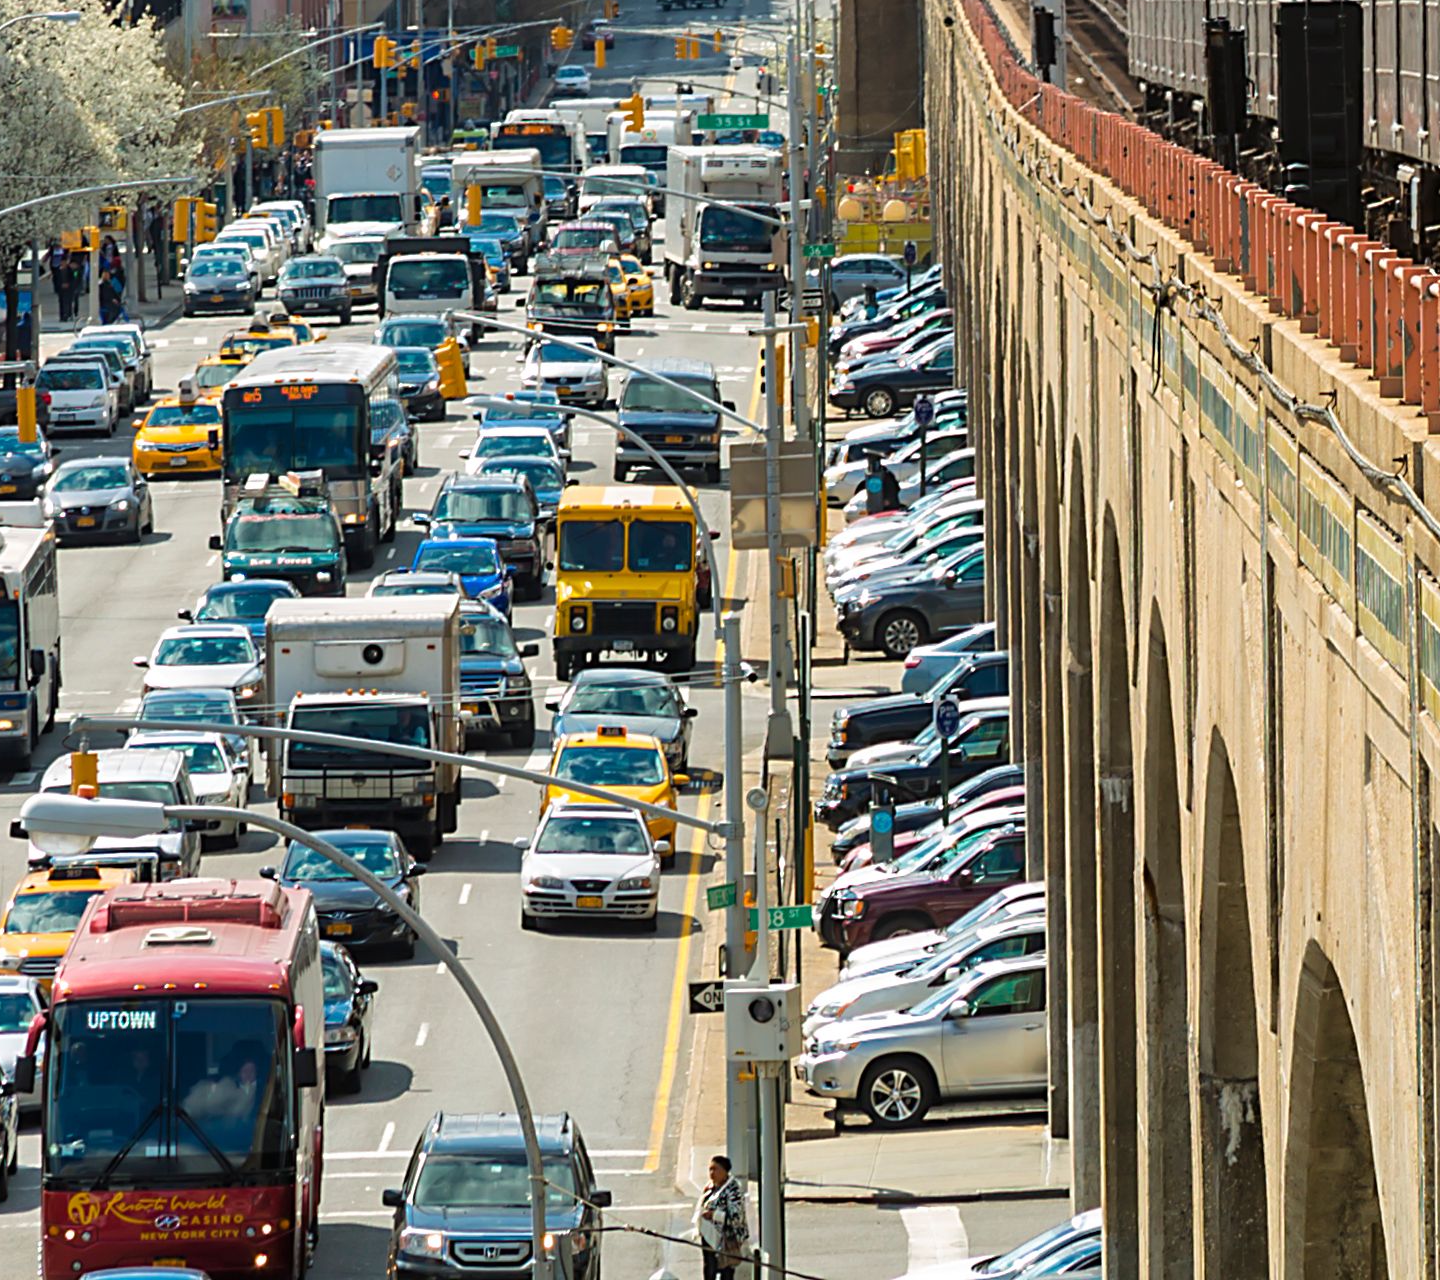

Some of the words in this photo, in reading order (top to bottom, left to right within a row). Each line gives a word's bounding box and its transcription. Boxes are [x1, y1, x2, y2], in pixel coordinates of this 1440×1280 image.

[715, 117, 732, 127] 35
[788, 910, 800, 919] ST
[703, 992, 724, 1004] ON
[87, 1011, 156, 1029] UPTOWN
[170, 1194, 227, 1210] World
[181, 1214, 245, 1225] CASINO
[140, 1232, 169, 1240] NEW
[173, 1230, 207, 1240] YORK
[210, 1229, 240, 1238] CITY
